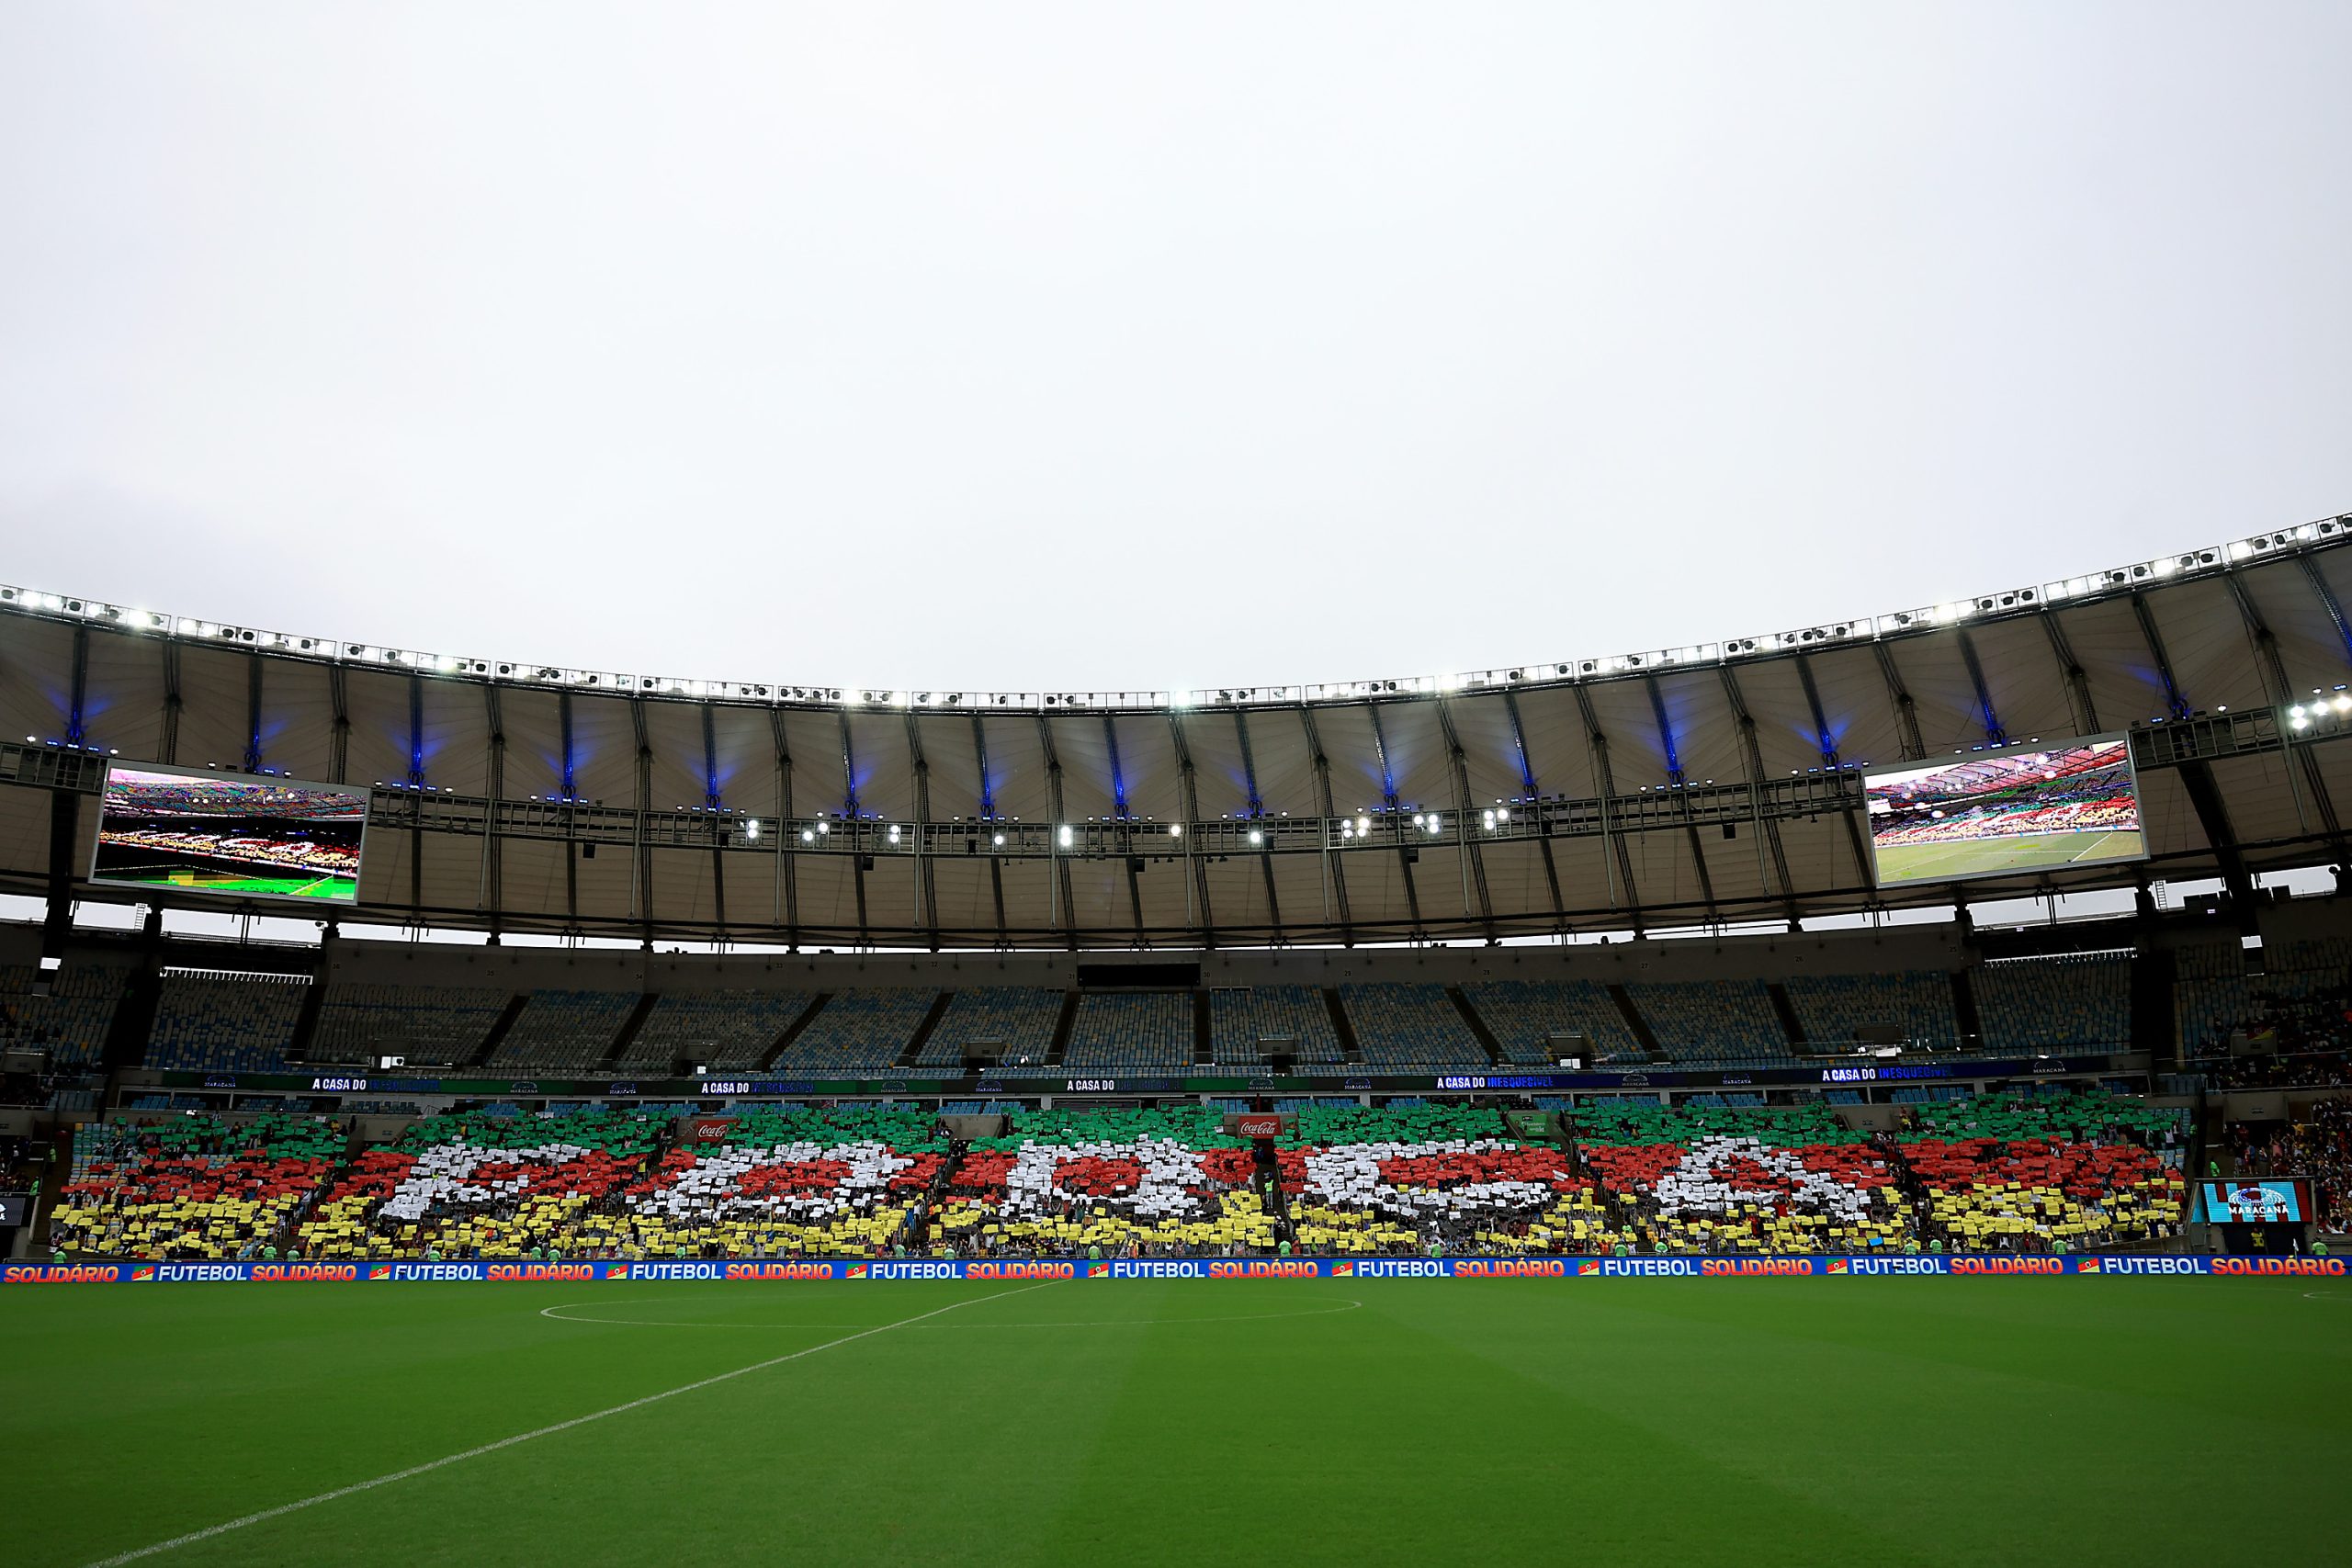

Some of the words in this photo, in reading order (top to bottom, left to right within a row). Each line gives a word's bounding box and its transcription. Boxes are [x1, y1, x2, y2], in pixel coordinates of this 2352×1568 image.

[1437, 1077, 1445, 1089] A
[1445, 1077, 1471, 1089] CASA
[1472, 1077, 1486, 1088] DO
[1822, 1070, 1831, 1081] A
[1831, 1068, 1861, 1081] CASA
[1861, 1068, 1876, 1080] DO
[311, 1078, 321, 1089] A
[322, 1078, 350, 1090] CASA
[352, 1078, 367, 1090] DO
[701, 1082, 709, 1093] A
[710, 1082, 735, 1093] CASA
[736, 1082, 750, 1093] DO
[1067, 1080, 1074, 1090] A
[1075, 1080, 1101, 1091] CASA
[1102, 1079, 1114, 1090] DO
[1240, 1122, 1278, 1134] Coca-Cola
[5, 1264, 119, 1282] SOLIDÁRIO
[159, 1265, 247, 1281] FUTEBOL
[252, 1263, 356, 1281] SOLIDÁRIO
[395, 1265, 482, 1280] FUTEBOL
[488, 1262, 594, 1280] SOLIDÁRIO
[632, 1264, 721, 1280] FUTEBOL
[726, 1261, 832, 1280] SOLIDÁRIO
[872, 1263, 962, 1279] FUTEBOL
[967, 1260, 1074, 1279] SOLIDÁRIO
[1114, 1262, 1204, 1278] FUTEBOL
[1209, 1259, 1318, 1278] SOLIDÁRIO
[1359, 1261, 1450, 1278] FUTEBOL
[1454, 1258, 1565, 1277] SOLIDÁRIO
[1605, 1260, 1697, 1276] FUTEBOL
[1702, 1257, 1813, 1275] SOLIDÁRIO
[1852, 1258, 1947, 1275] FUTEBOL
[1951, 1255, 2064, 1274] SOLIDÁRIO
[2104, 1258, 2207, 1274] FUTEBOL
[2211, 1256, 2345, 1275] SOLIDÁRIO
